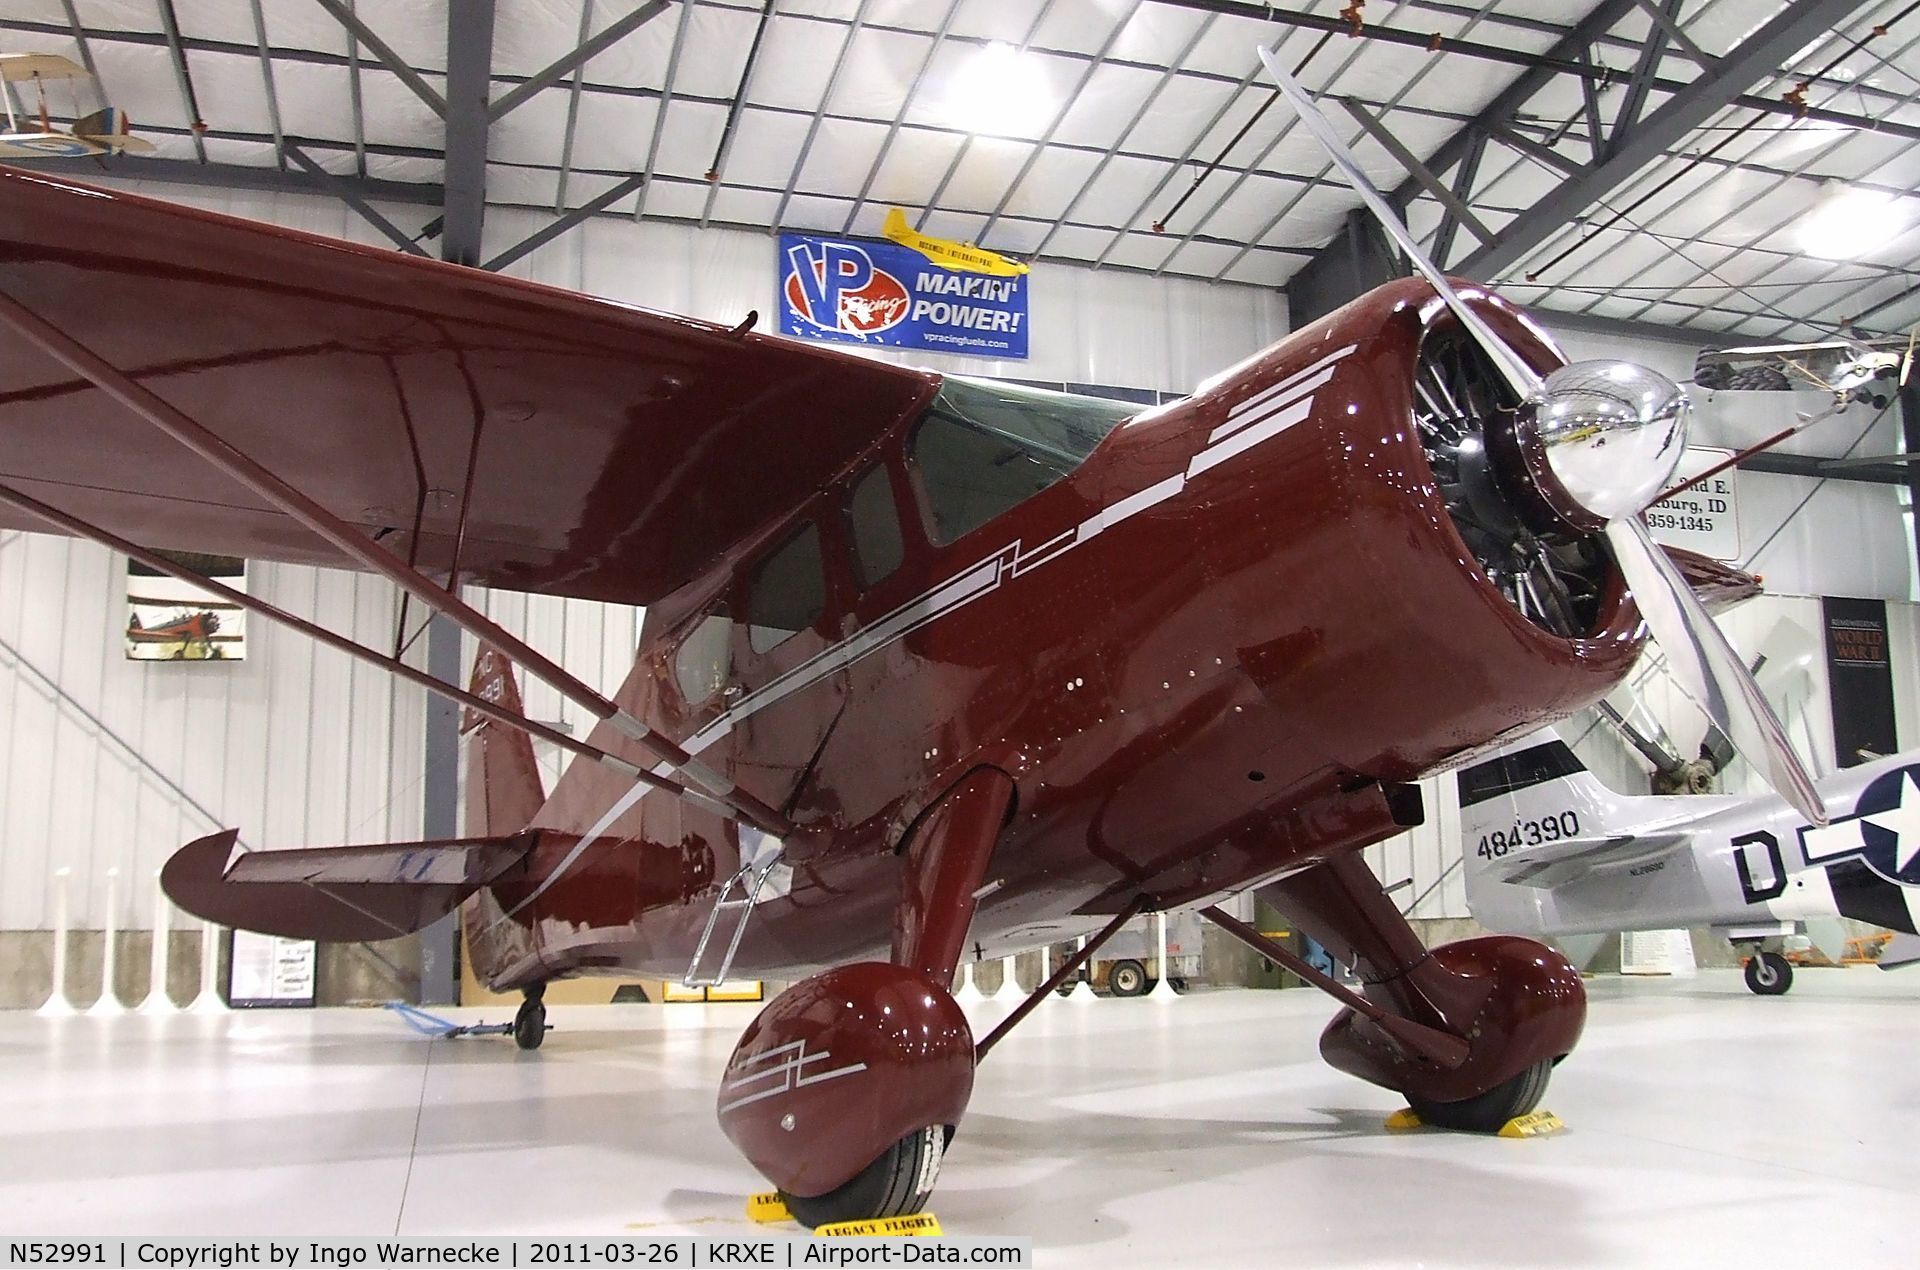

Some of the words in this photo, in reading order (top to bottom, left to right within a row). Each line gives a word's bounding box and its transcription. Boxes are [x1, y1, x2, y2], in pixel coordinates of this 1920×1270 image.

[787, 241, 874, 332] VP
[915, 272, 1018, 302] MAKIN'
[911, 300, 1020, 333] POWER!
[923, 333, 1009, 349] vpracingfuels.com
[1714, 480, 1730, 494] E.
[1708, 498, 1727, 513] ID
[1832, 630, 1882, 645] WORLD
[1835, 645, 1869, 659] WAR
[1478, 810, 1580, 860] 484390
[1731, 829, 1788, 904] D
[757, 1195, 782, 1206] LEG
[826, 1224, 877, 1237] LEGACY
[885, 1217, 935, 1232] FLIGHT
